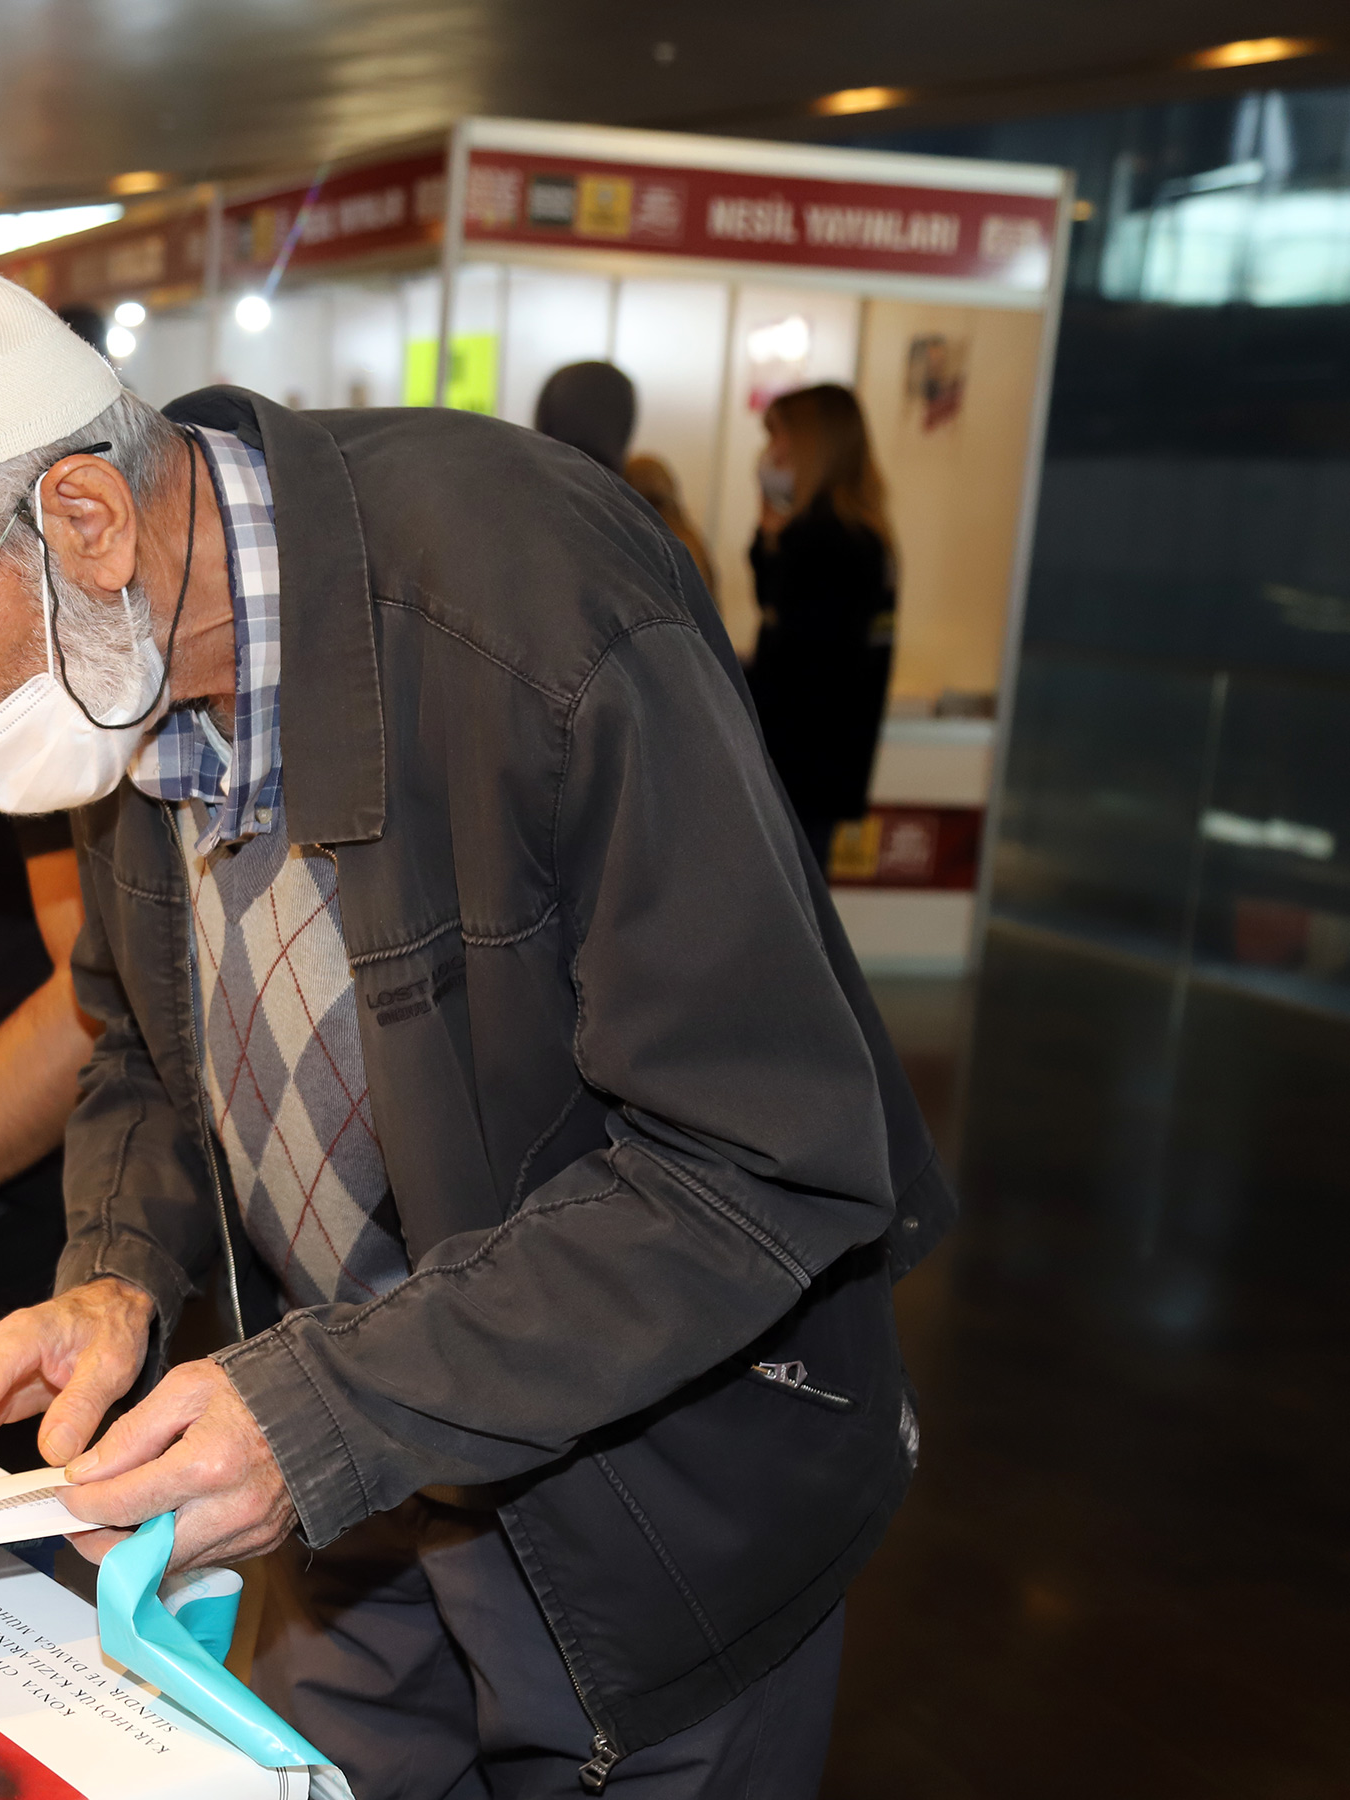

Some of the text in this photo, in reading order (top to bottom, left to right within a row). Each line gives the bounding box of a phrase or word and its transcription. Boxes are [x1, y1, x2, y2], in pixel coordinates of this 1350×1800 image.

[37, 1636, 88, 1672] DAMGA
[86, 1672, 108, 1687] VE
[22, 1680, 75, 1717] KONYA
[109, 1688, 178, 1733] SİLİNDİR
[69, 1689, 170, 1754] KARAHÖYÜK
